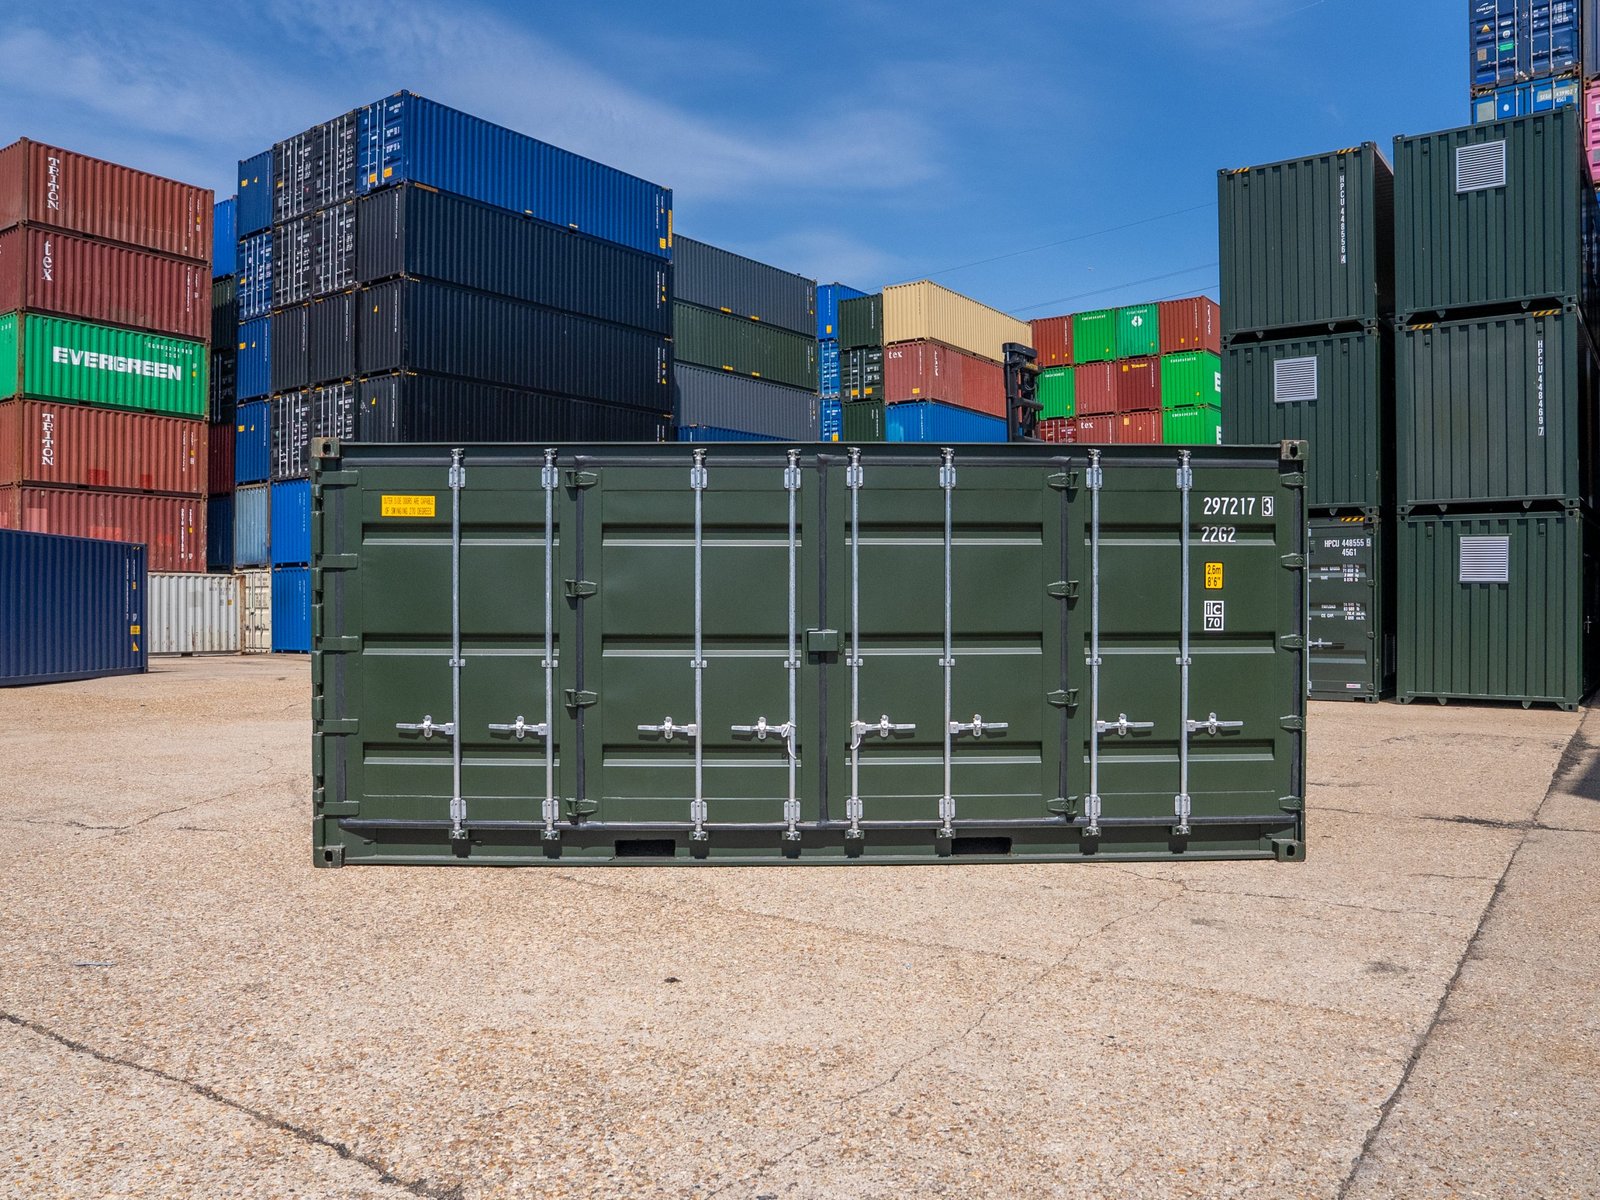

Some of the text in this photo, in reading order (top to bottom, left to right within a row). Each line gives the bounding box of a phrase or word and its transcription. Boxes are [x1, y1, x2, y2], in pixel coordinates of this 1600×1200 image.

[47, 156, 60, 210] TRITON
[41, 240, 53, 281] tex
[53, 346, 181, 381] EVERGREEN
[888, 351, 903, 359] tex
[42, 413, 54, 466] TRITON
[1203, 496, 1273, 516] 297217 3
[1201, 526, 1236, 543] 22G2
[1324, 540, 1340, 548] HPCU
[1341, 539, 1365, 547] 448555
[1341, 548, 1357, 556] 45G1
[1207, 618, 1221, 628] 70
